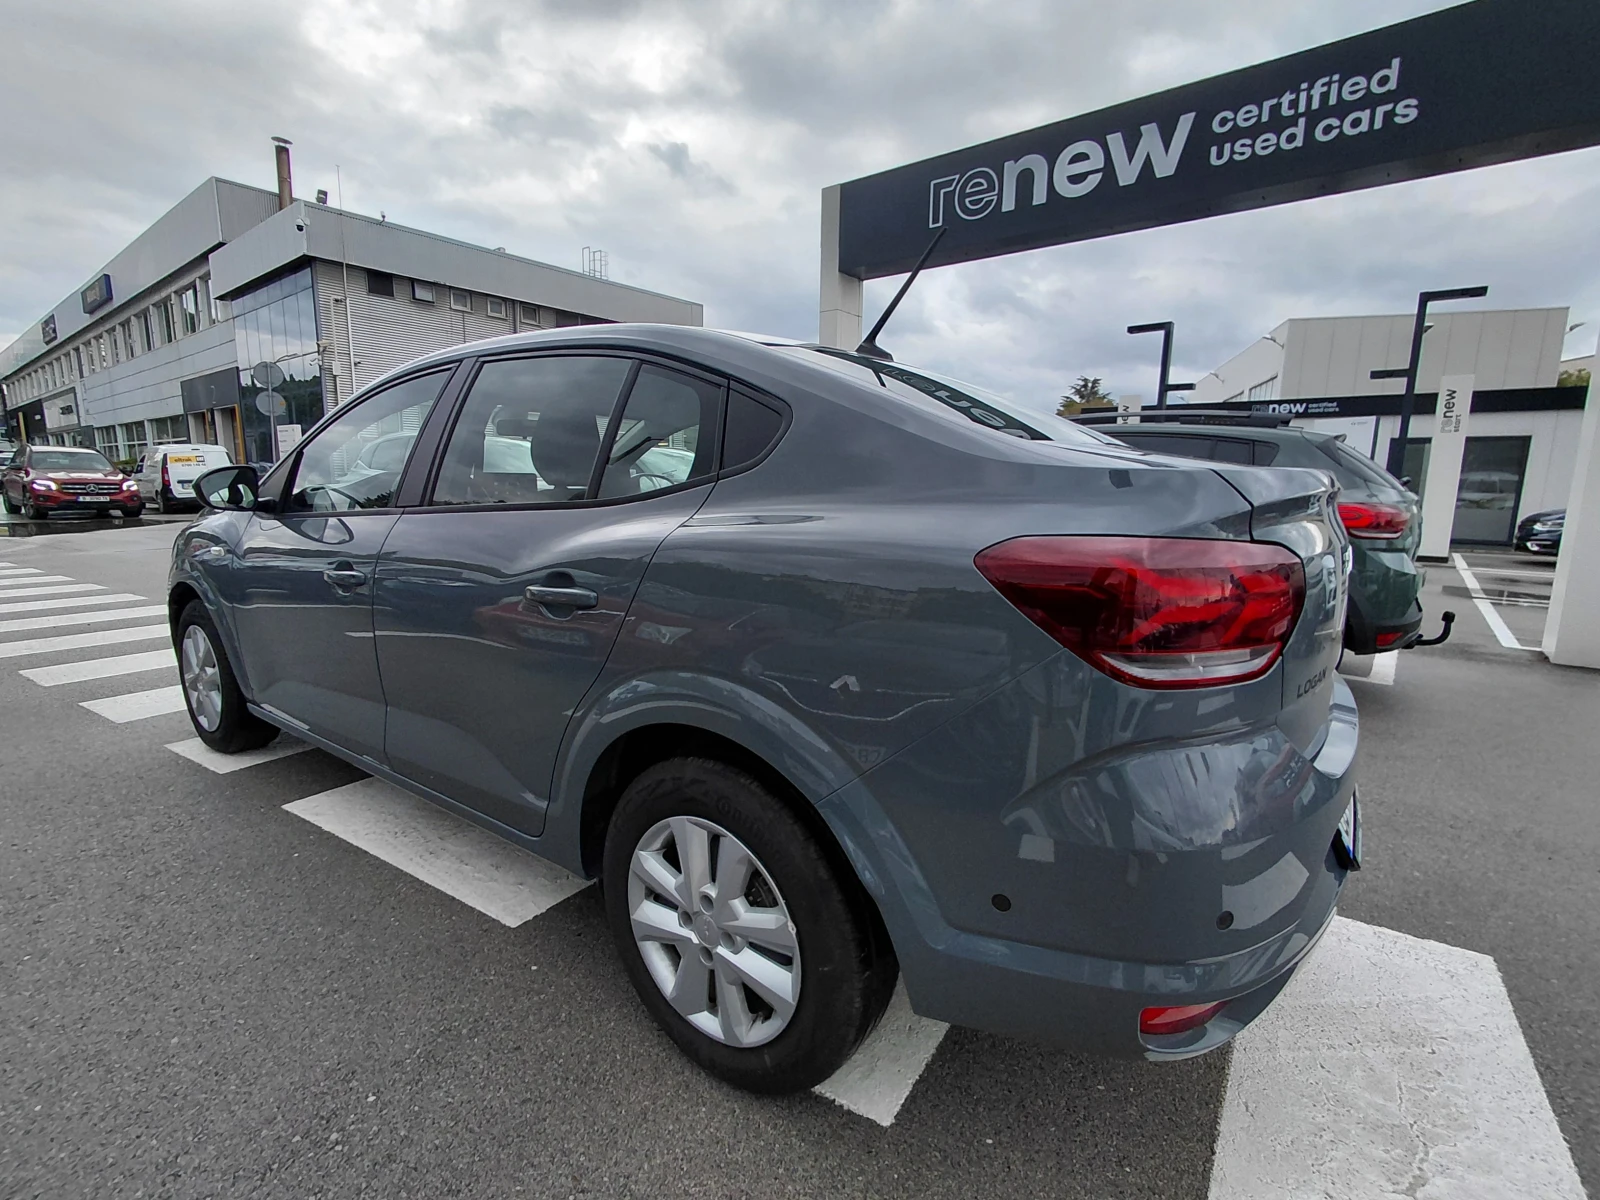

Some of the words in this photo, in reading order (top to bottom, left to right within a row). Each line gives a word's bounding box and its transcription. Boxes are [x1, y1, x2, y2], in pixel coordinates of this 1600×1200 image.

[1211, 57, 1400, 133] certified
[1209, 117, 1306, 166] used
[1314, 98, 1419, 142] cars
[928, 111, 1197, 228] renew
[1252, 402, 1307, 414] renew
[1308, 401, 1337, 409] certified
[1440, 388, 1457, 434] renew
[1453, 413, 1462, 433] start
[1296, 665, 1328, 699] LOGAN
